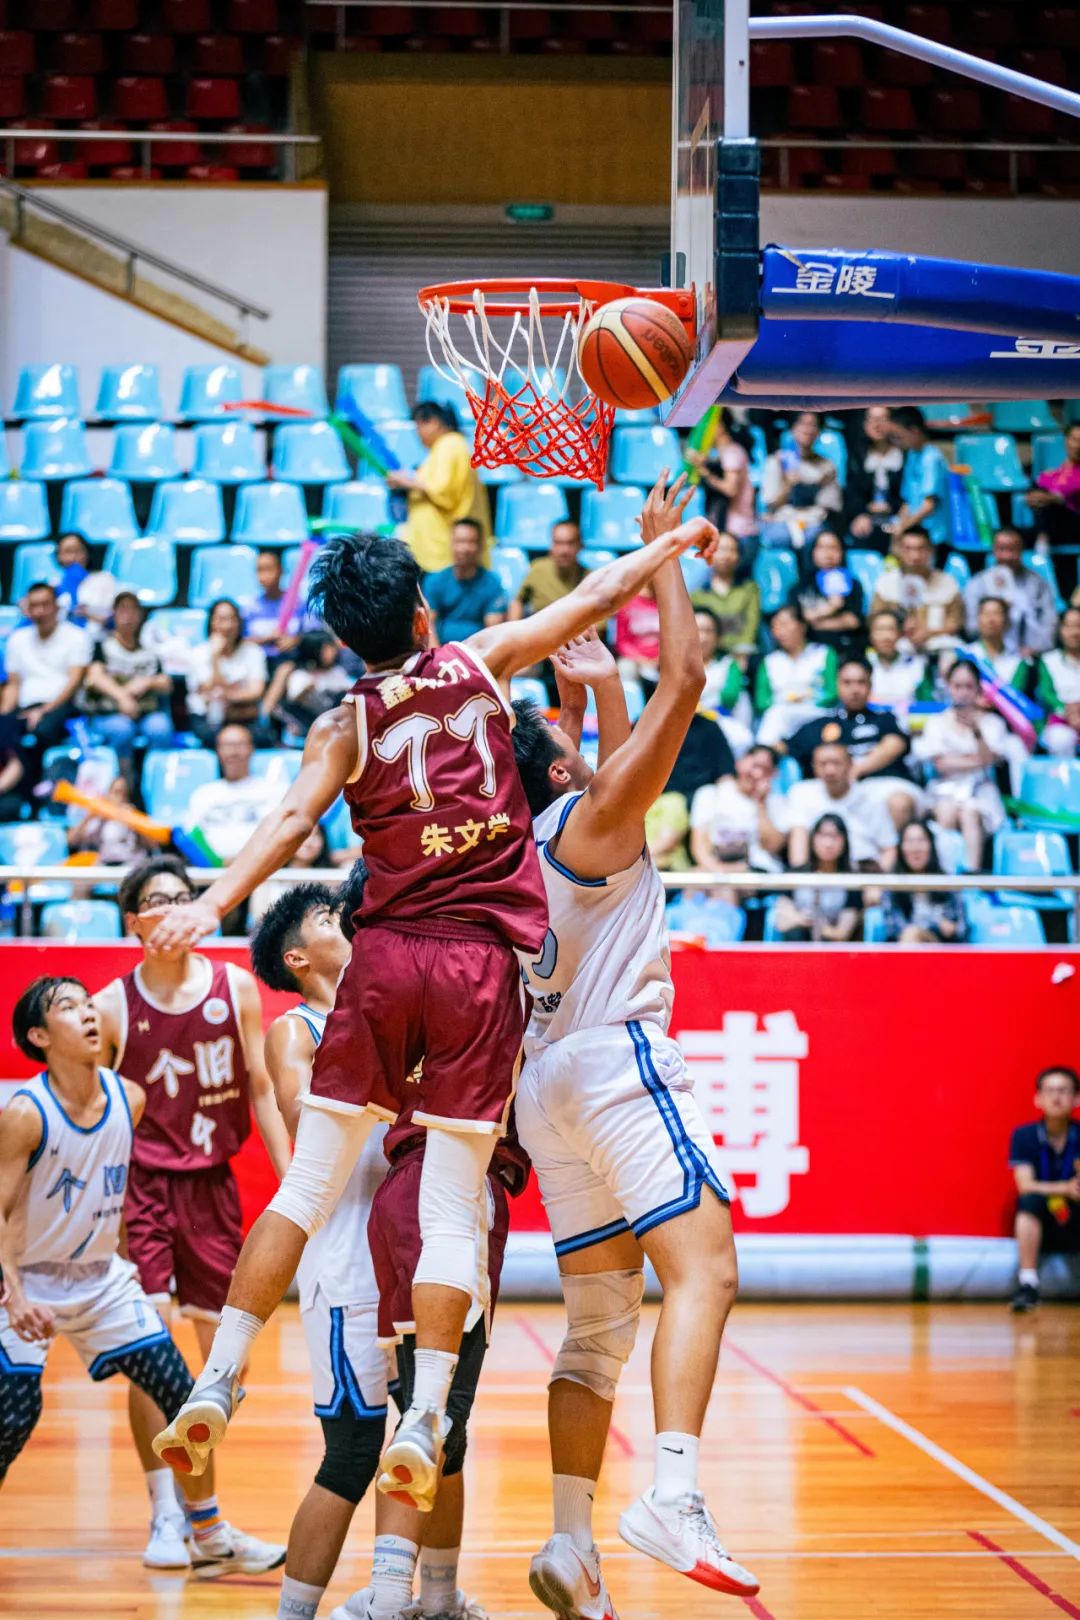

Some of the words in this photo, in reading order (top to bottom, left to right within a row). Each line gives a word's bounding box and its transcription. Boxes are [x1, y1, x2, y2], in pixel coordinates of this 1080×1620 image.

[772, 262, 895, 298] 金陵
[372, 692, 501, 812] 77
[145, 1035, 235, 1098] 个旧
